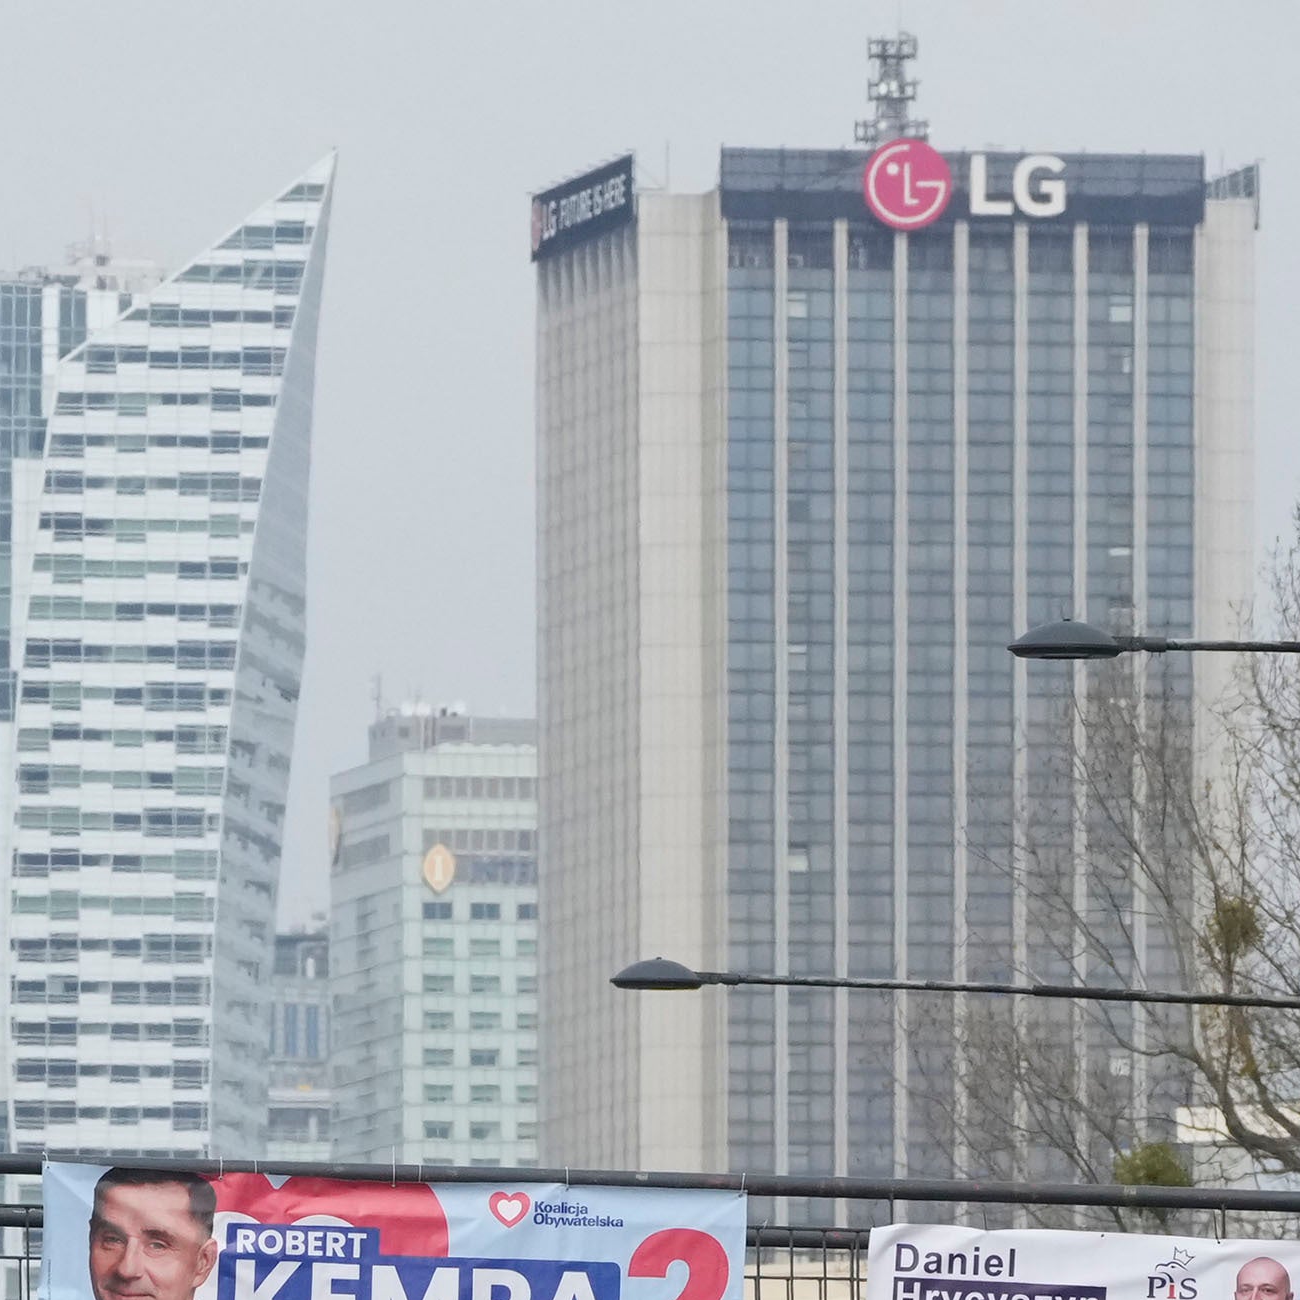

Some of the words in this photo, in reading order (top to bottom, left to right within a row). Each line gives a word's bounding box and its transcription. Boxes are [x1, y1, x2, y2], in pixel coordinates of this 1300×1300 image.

[969, 155, 1067, 218] LG
[534, 1200, 590, 1218] Koalicja
[534, 1213, 624, 1229] Obywatelska
[235, 1229, 368, 1260] ROBERT
[894, 1243, 1017, 1277] Daniel
[1147, 1275, 1198, 1300] PiS
